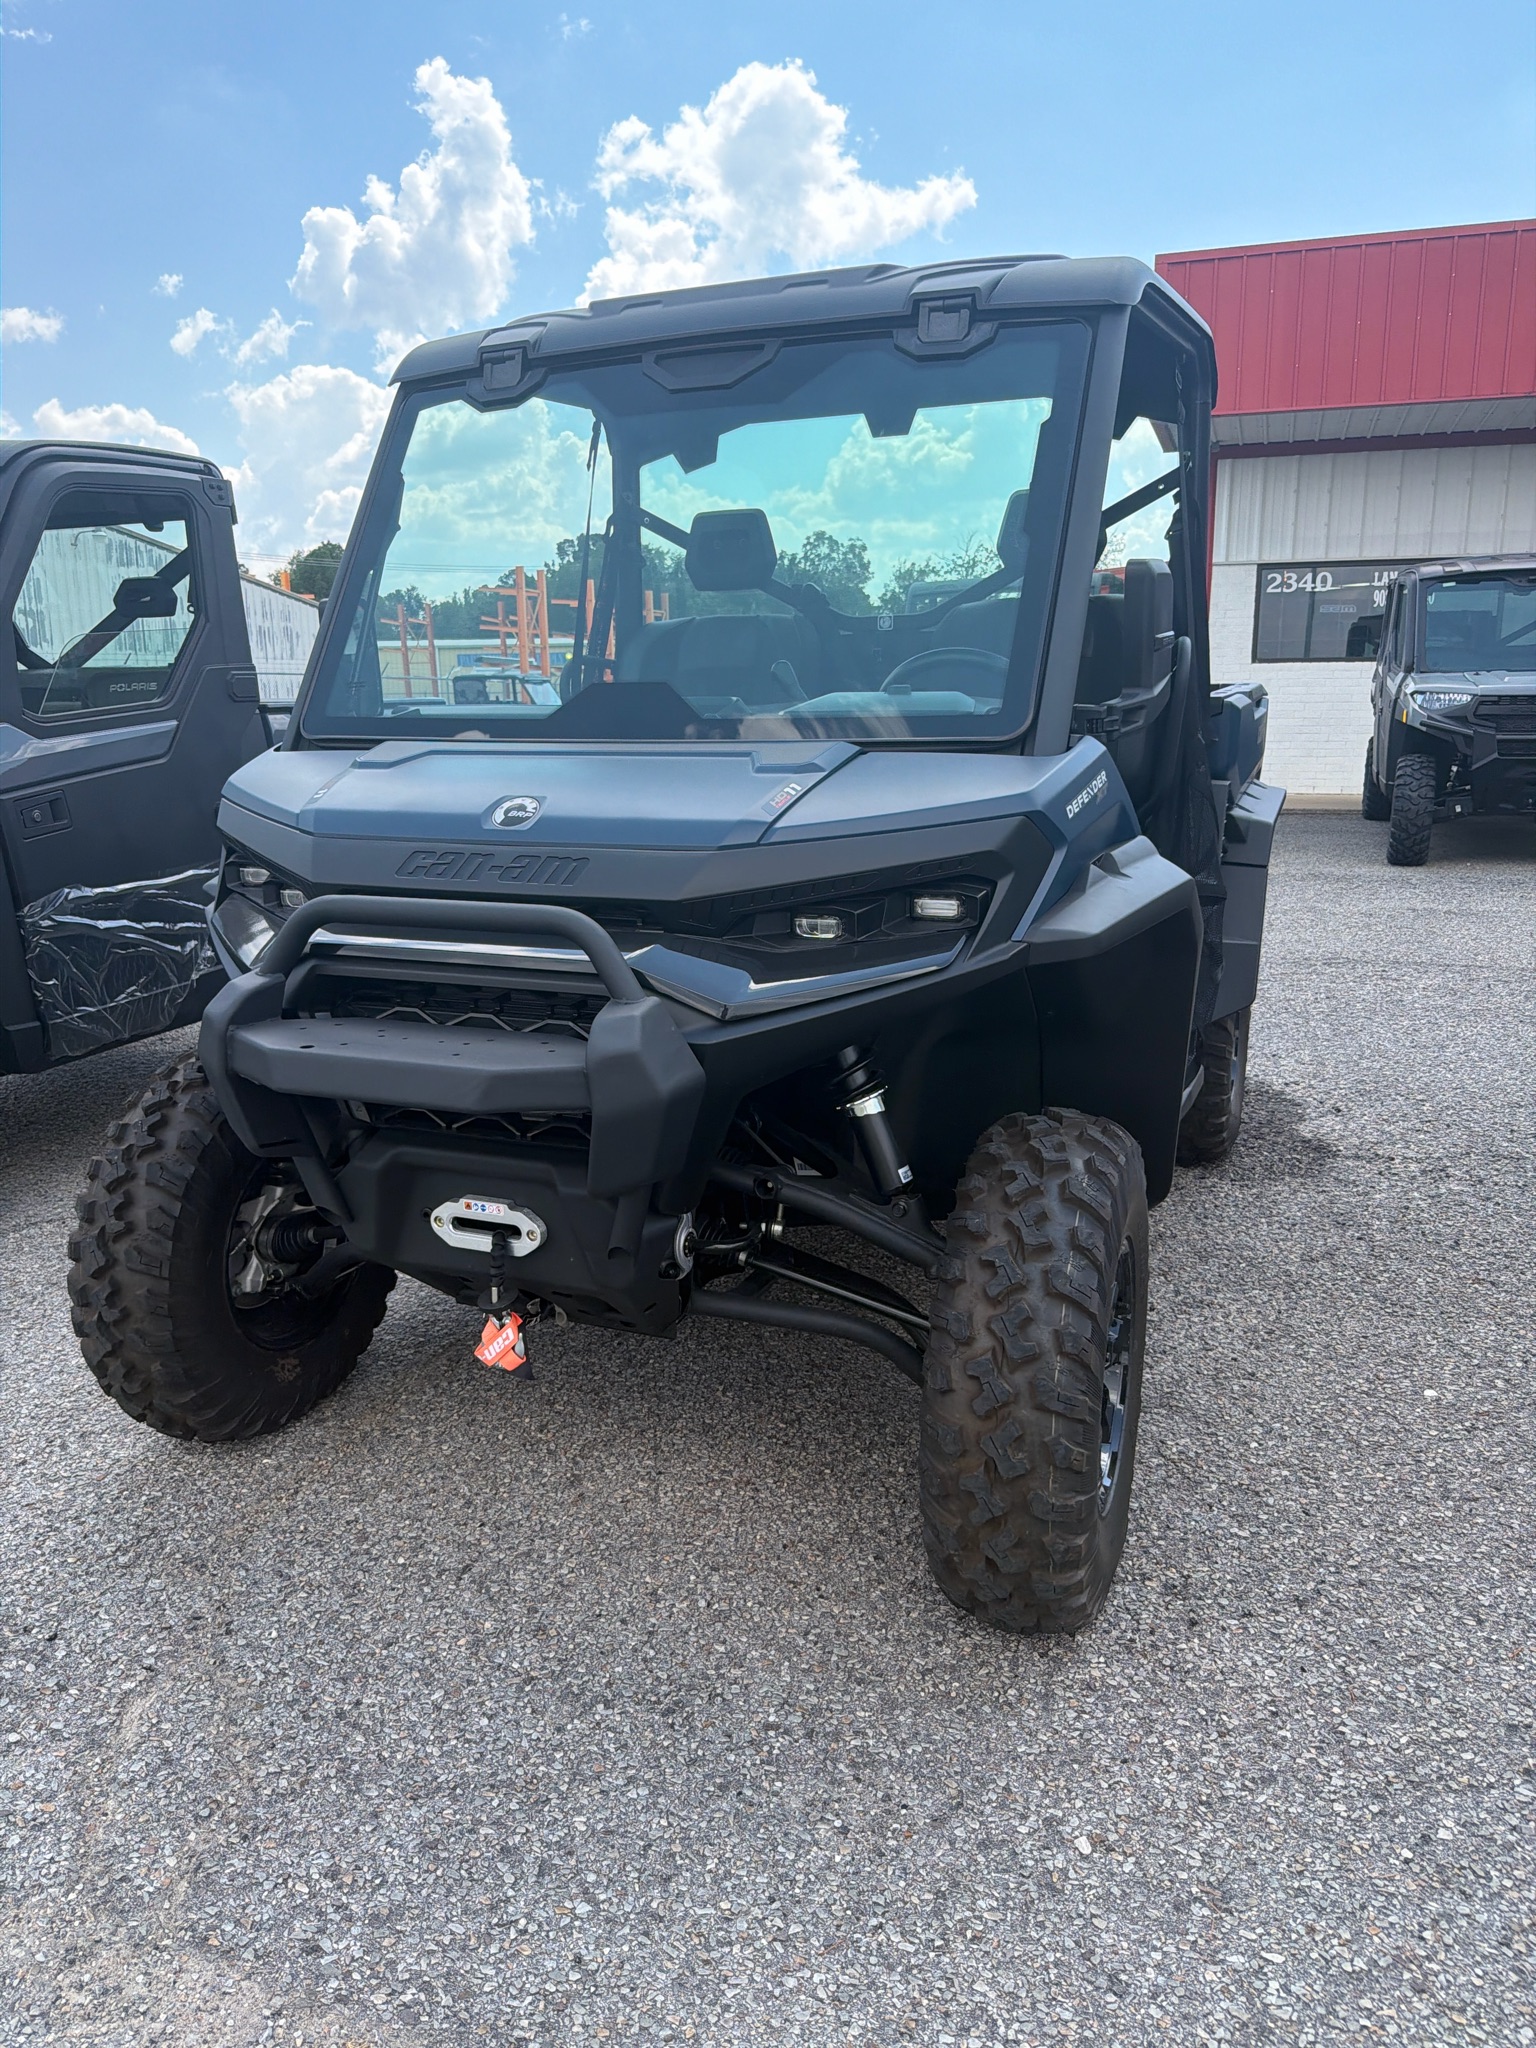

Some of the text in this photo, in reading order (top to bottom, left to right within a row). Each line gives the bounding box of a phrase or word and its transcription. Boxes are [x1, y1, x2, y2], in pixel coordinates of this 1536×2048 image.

[1266, 571, 1333, 593] 2340
[1373, 589, 1388, 607] 90
[110, 682, 158, 693] POLARIS
[1066, 770, 1107, 819] DEFENDER
[507, 810, 533, 818] BRP
[394, 850, 590, 886] can-am
